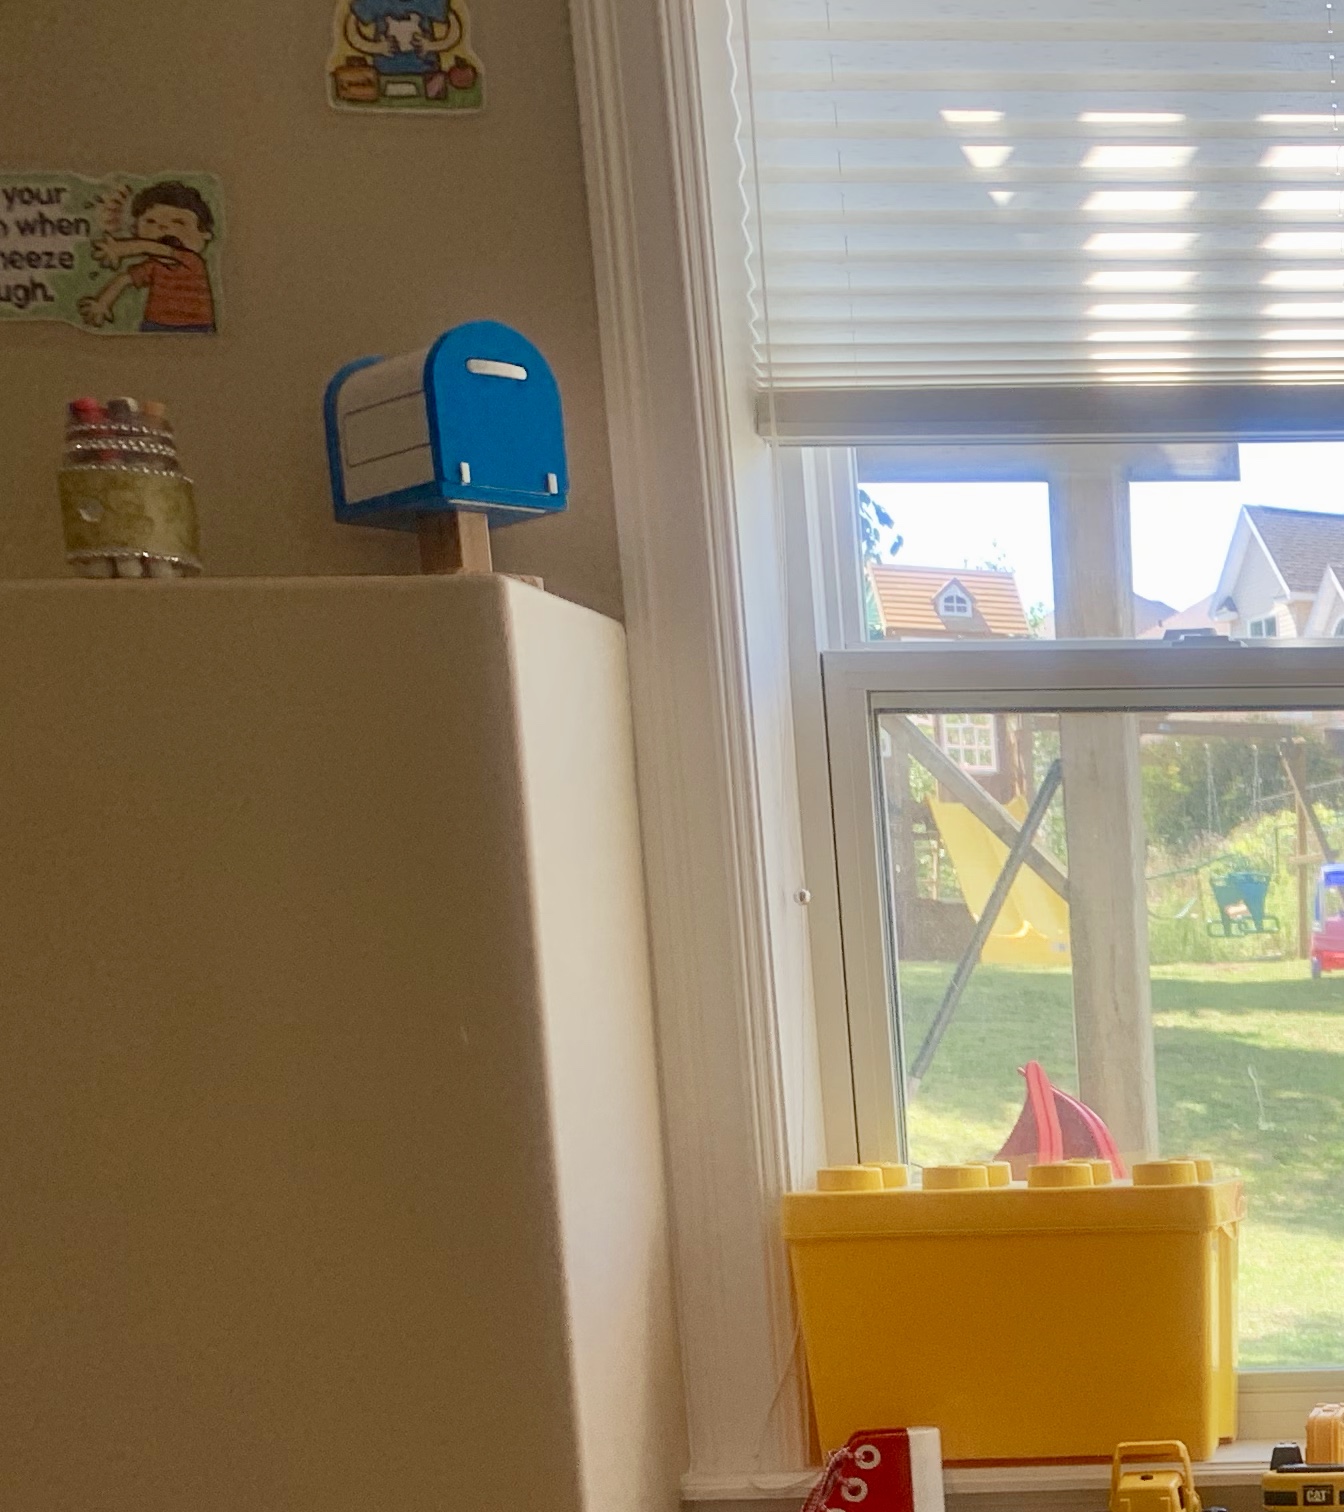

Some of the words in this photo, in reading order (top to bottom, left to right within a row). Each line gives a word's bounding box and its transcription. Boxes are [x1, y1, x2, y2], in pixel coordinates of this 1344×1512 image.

[2, 186, 67, 212] your
[16, 211, 91, 237] when
[1305, 1489, 1327, 1503] CAT
